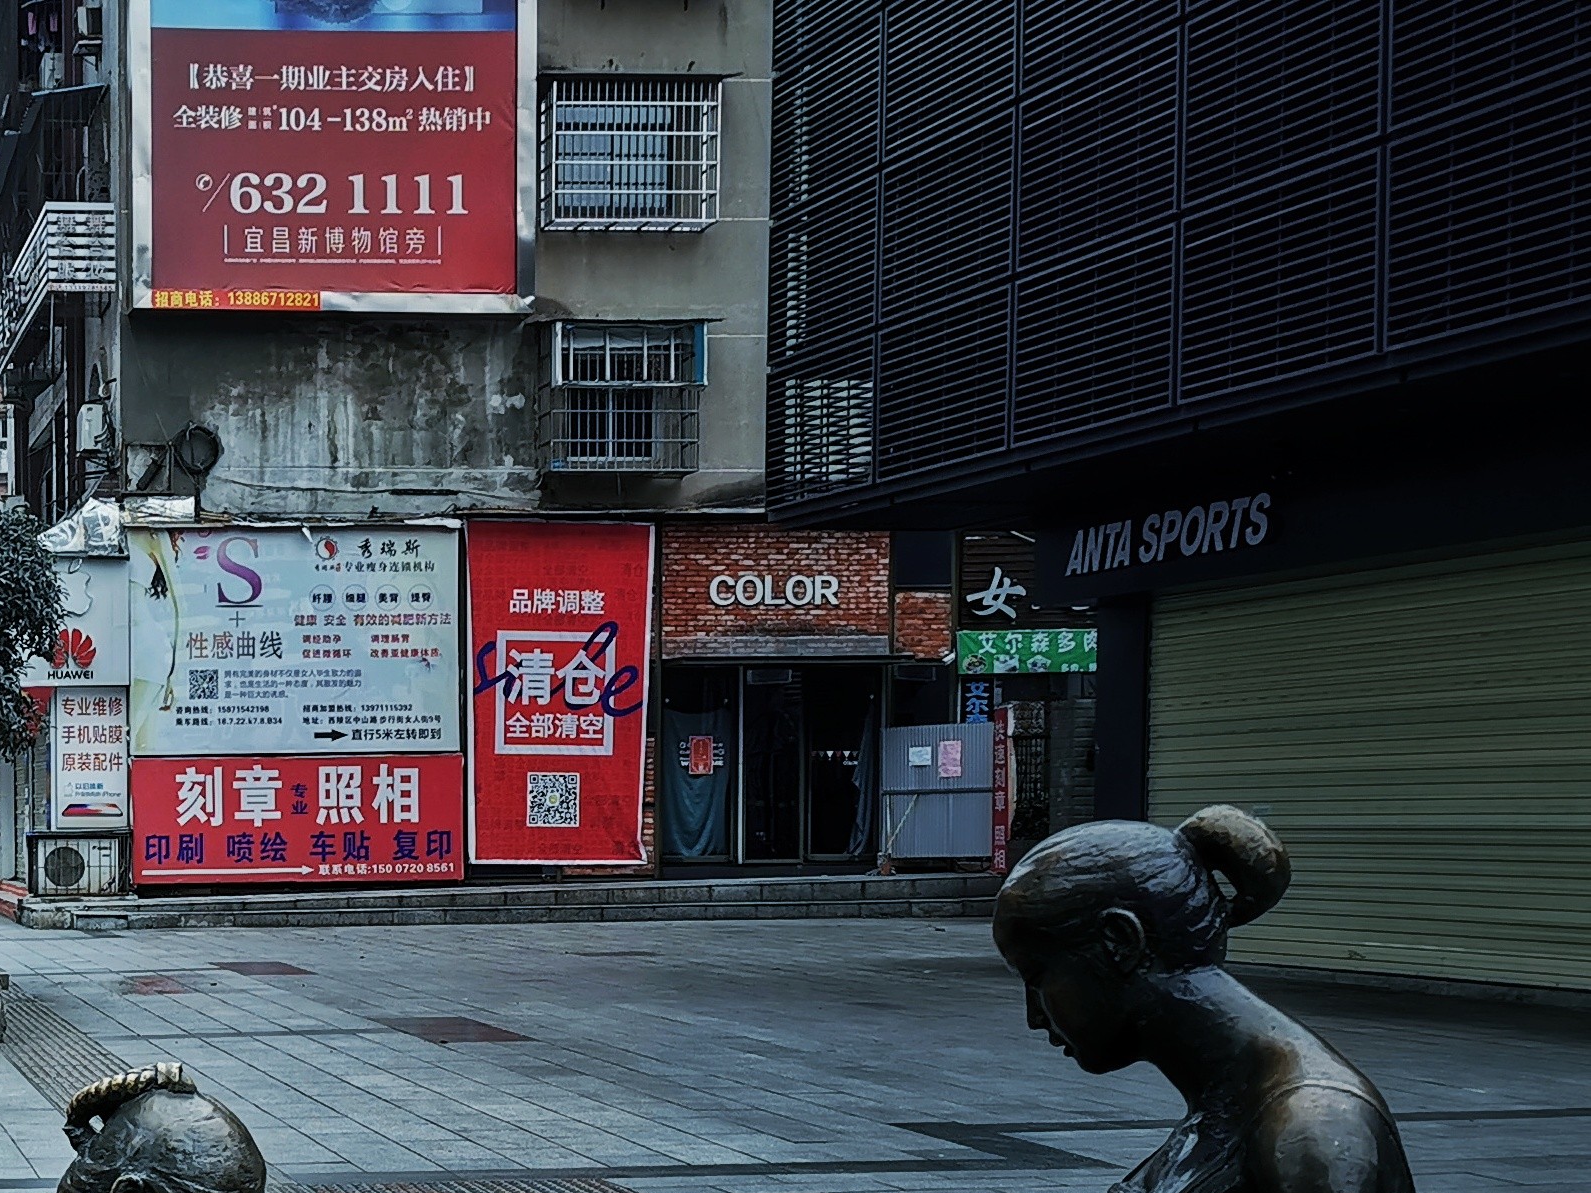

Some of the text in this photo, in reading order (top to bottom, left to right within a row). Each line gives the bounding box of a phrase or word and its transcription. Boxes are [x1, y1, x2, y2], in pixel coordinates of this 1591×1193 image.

[418, 106, 492, 132] 热销中
[229, 172, 470, 215] 632 1111
[244, 226, 426, 254] 宜昌新博物馆旁
[1064, 492, 1271, 577] ANTA SPORTS
[216, 536, 263, 605] S
[509, 588, 606, 615] 品牌调整
[710, 574, 840, 606] COLOR
[294, 614, 317, 627] 健康
[324, 614, 347, 626] 安全
[186, 630, 283, 660] 性感曲线
[47, 670, 94, 680] HUAWEI
[506, 648, 607, 706] 清仓
[61, 697, 124, 717] 专业维修
[61, 725, 124, 745] 手机贴膜
[351, 728, 442, 741] 直行5米左转即到
[505, 712, 604, 739] 全部清空
[61, 753, 124, 773] 原装配件
[175, 763, 420, 827] 刻章 专业 照相
[144, 828, 453, 865] 印刷 喷绘 车贴 复印
